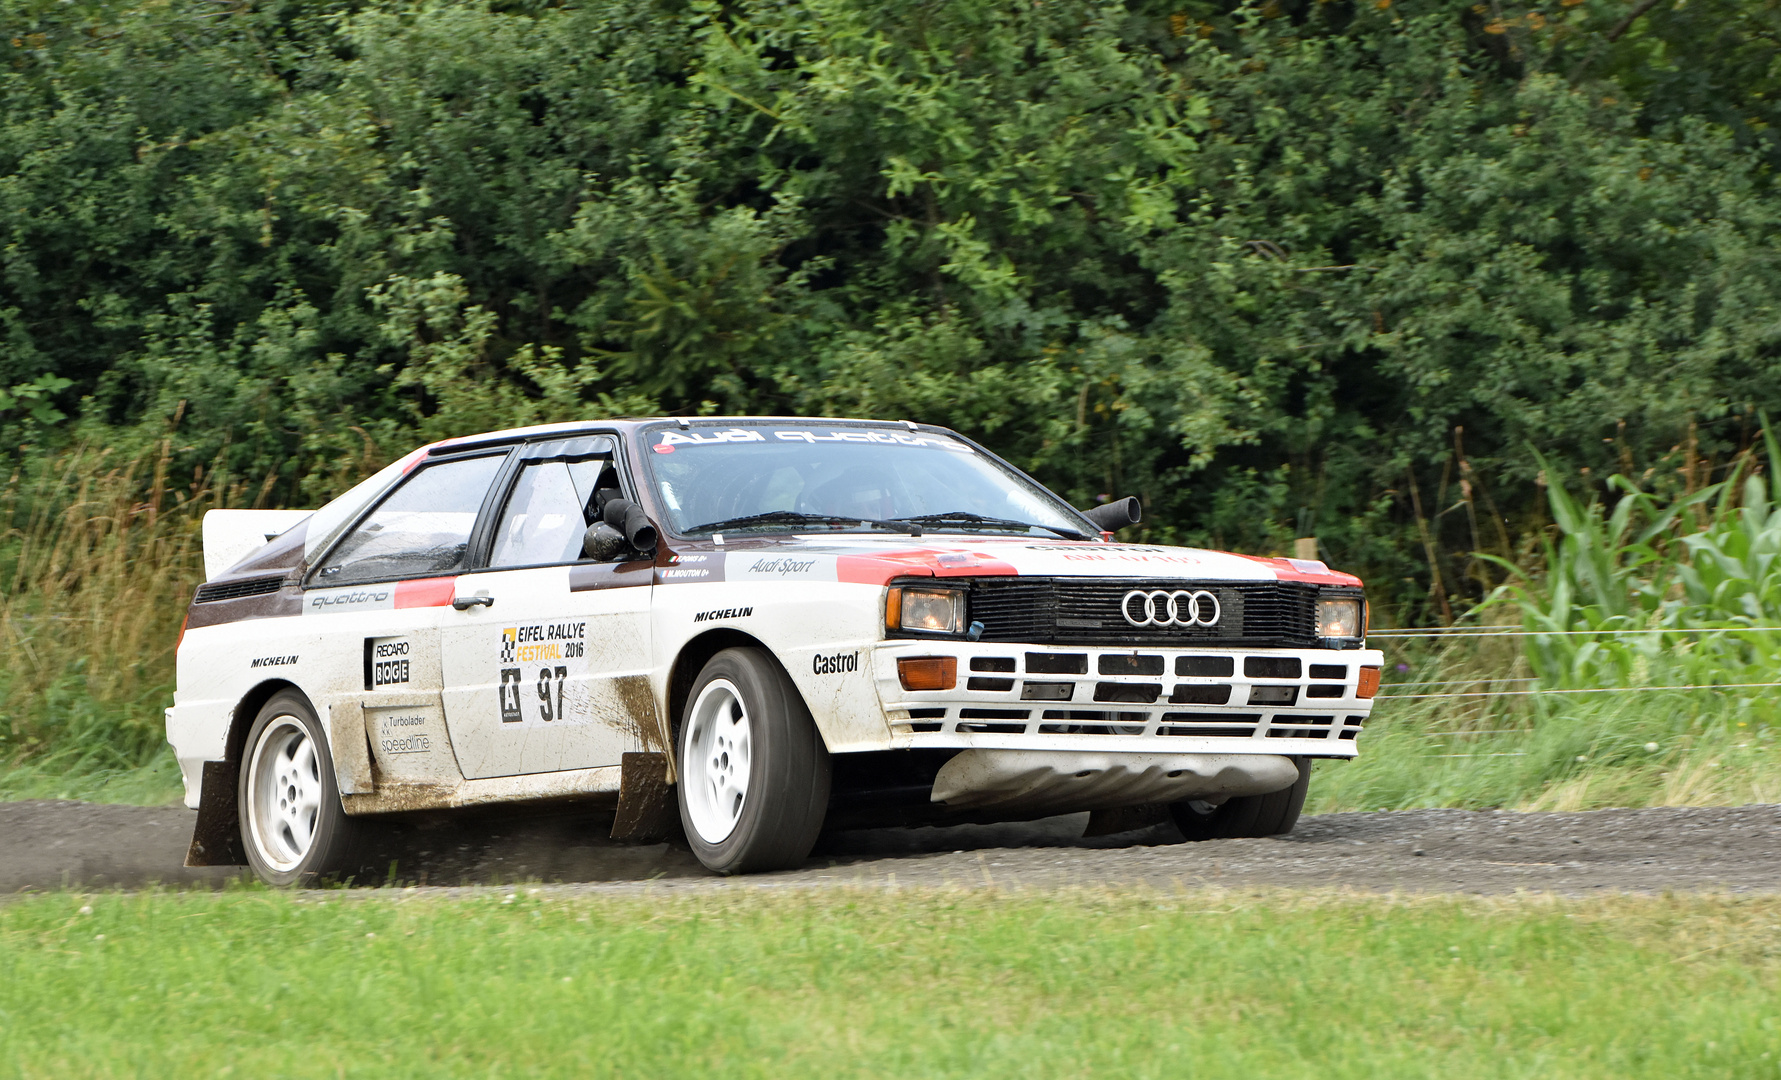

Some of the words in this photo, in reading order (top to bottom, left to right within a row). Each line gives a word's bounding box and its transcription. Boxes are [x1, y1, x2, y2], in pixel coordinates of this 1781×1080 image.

[661, 428, 765, 445] Audi
[774, 431, 975, 453] quattro
[749, 558, 782, 573] Audi
[778, 558, 816, 576] Sport
[312, 591, 389, 610] quattro
[694, 606, 754, 623] MICHELIN
[518, 625, 545, 643] EIFEL
[547, 622, 586, 640] RALLYE
[376, 642, 410, 658] RECARO
[516, 643, 562, 662] FESTIVAL
[565, 641, 584, 658] 2016
[250, 654, 300, 669] MICHELIN
[813, 650, 859, 675] Castrol
[376, 661, 409, 683] BOGE
[537, 665, 567, 722] 97
[389, 715, 426, 727] Turbolader
[382, 734, 431, 753] speedline
